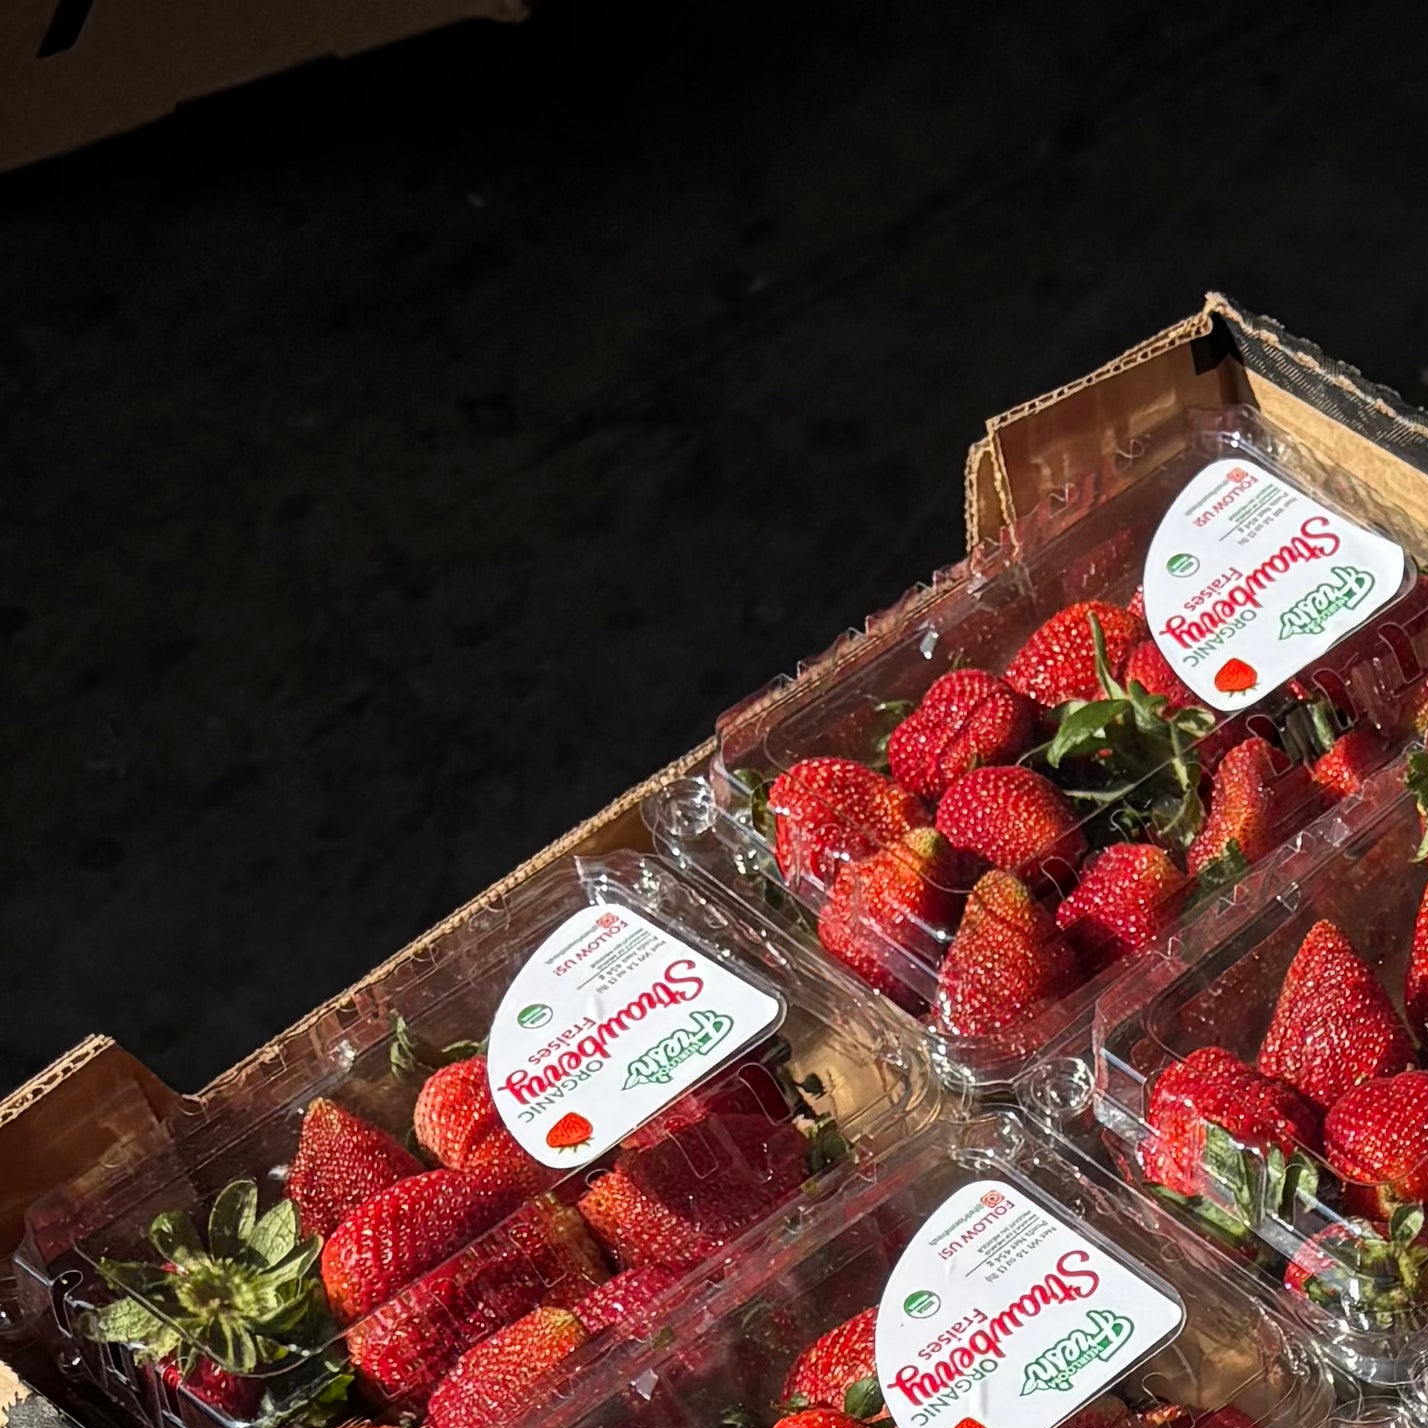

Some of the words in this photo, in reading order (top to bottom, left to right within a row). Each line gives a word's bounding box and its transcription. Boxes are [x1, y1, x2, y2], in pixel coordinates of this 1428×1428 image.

[1160, 516, 1340, 649] Strawberry
[1183, 566, 1243, 611] Fraises
[1279, 565, 1373, 636] Fresh
[1183, 609, 1256, 668] ORGANIC
[497, 959, 703, 1106] Strawberry
[528, 1015, 597, 1065] Fraises
[627, 1009, 731, 1085] Fresh
[517, 1060, 603, 1125] ORGANIC
[888, 1250, 1100, 1406] Strawberry
[917, 1307, 988, 1360] Fraises
[1023, 1308, 1132, 1393] Fresh
[910, 1359, 998, 1427] ORGANIC
